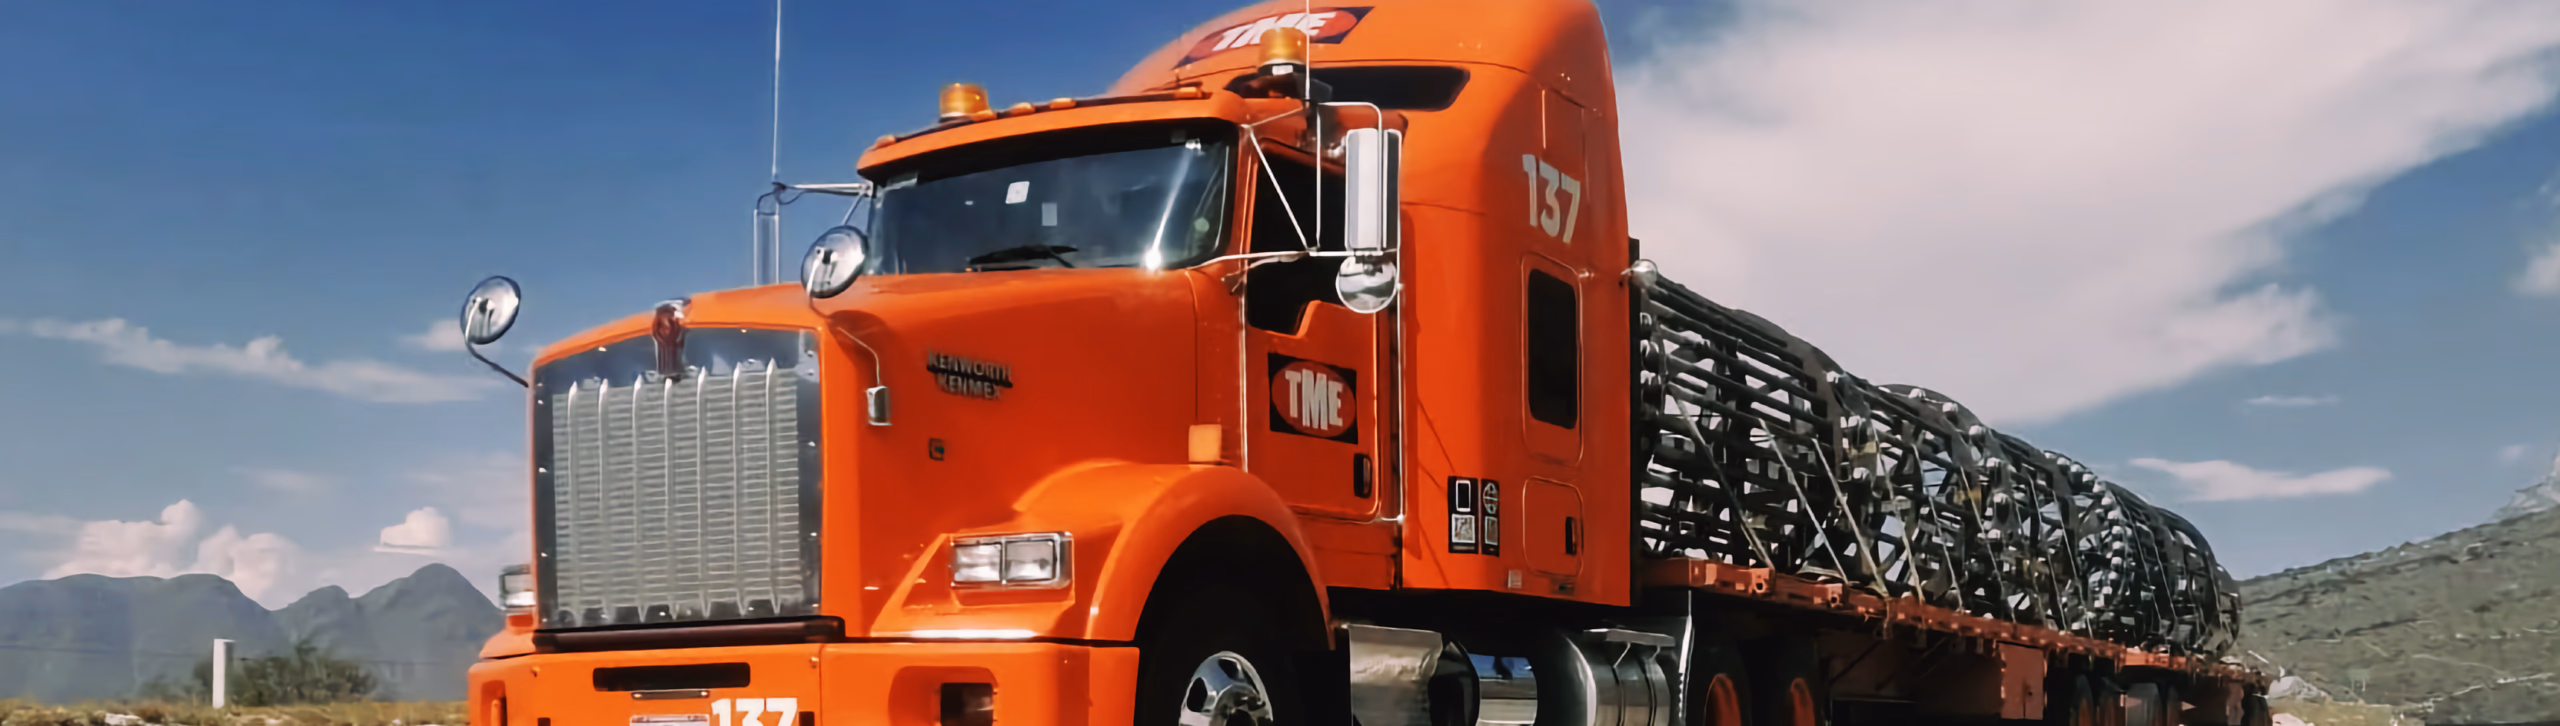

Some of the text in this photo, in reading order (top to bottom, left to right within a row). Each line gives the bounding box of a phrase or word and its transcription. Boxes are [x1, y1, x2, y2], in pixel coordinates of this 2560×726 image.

[1522, 153, 1581, 244] 137
[926, 350, 1012, 383] KENWORTH
[1285, 368, 1344, 431] TME
